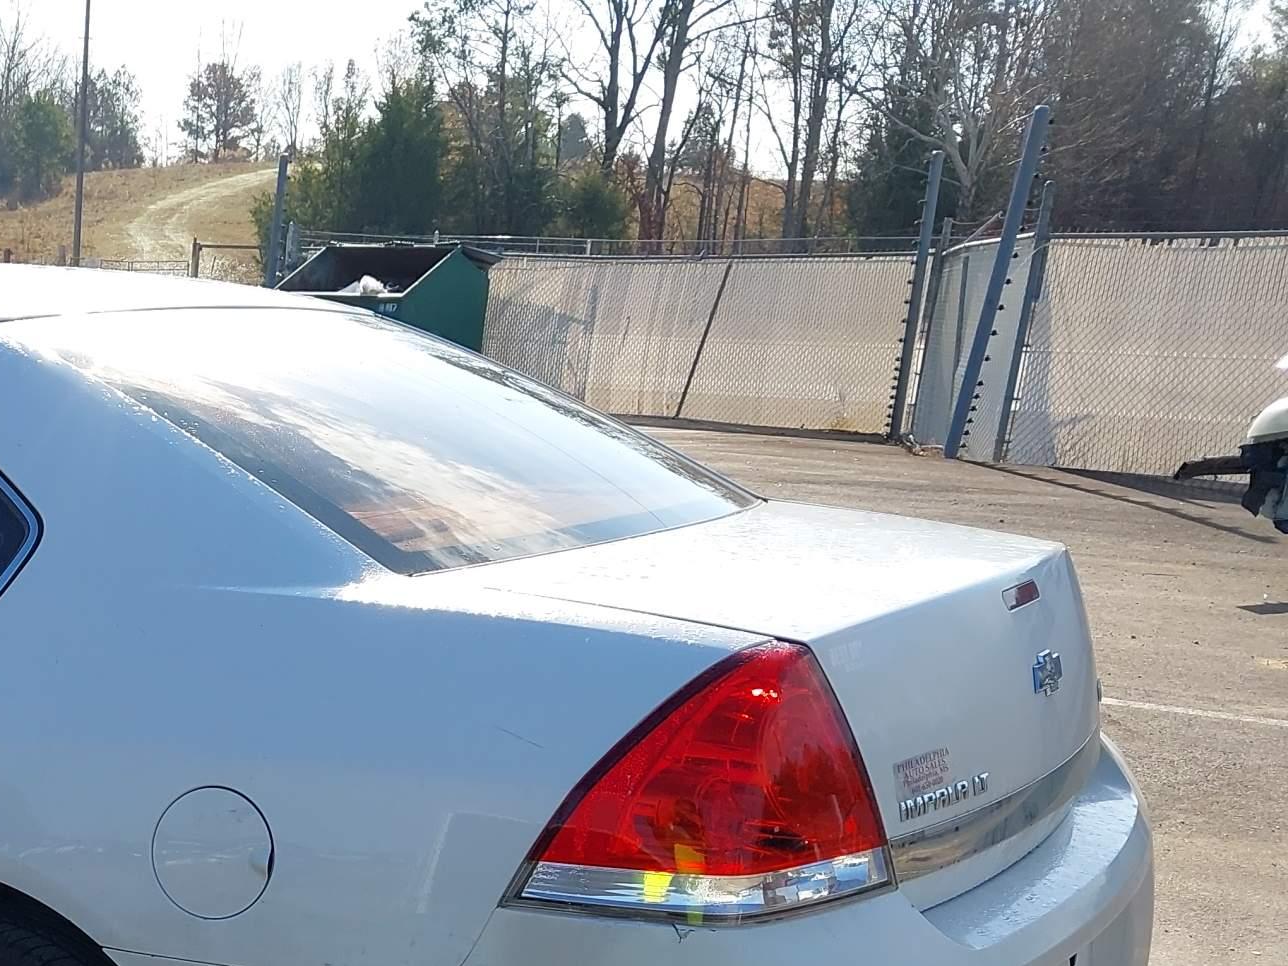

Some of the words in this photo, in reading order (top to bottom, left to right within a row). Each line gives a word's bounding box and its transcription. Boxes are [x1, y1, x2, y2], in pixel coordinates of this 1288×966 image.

[897, 747, 950, 774] PHILADELPHIA
[904, 766, 924, 780] AUTO
[924, 759, 946, 772] SALES
[899, 780, 969, 823] IMPALA
[972, 772, 990, 797] LT
